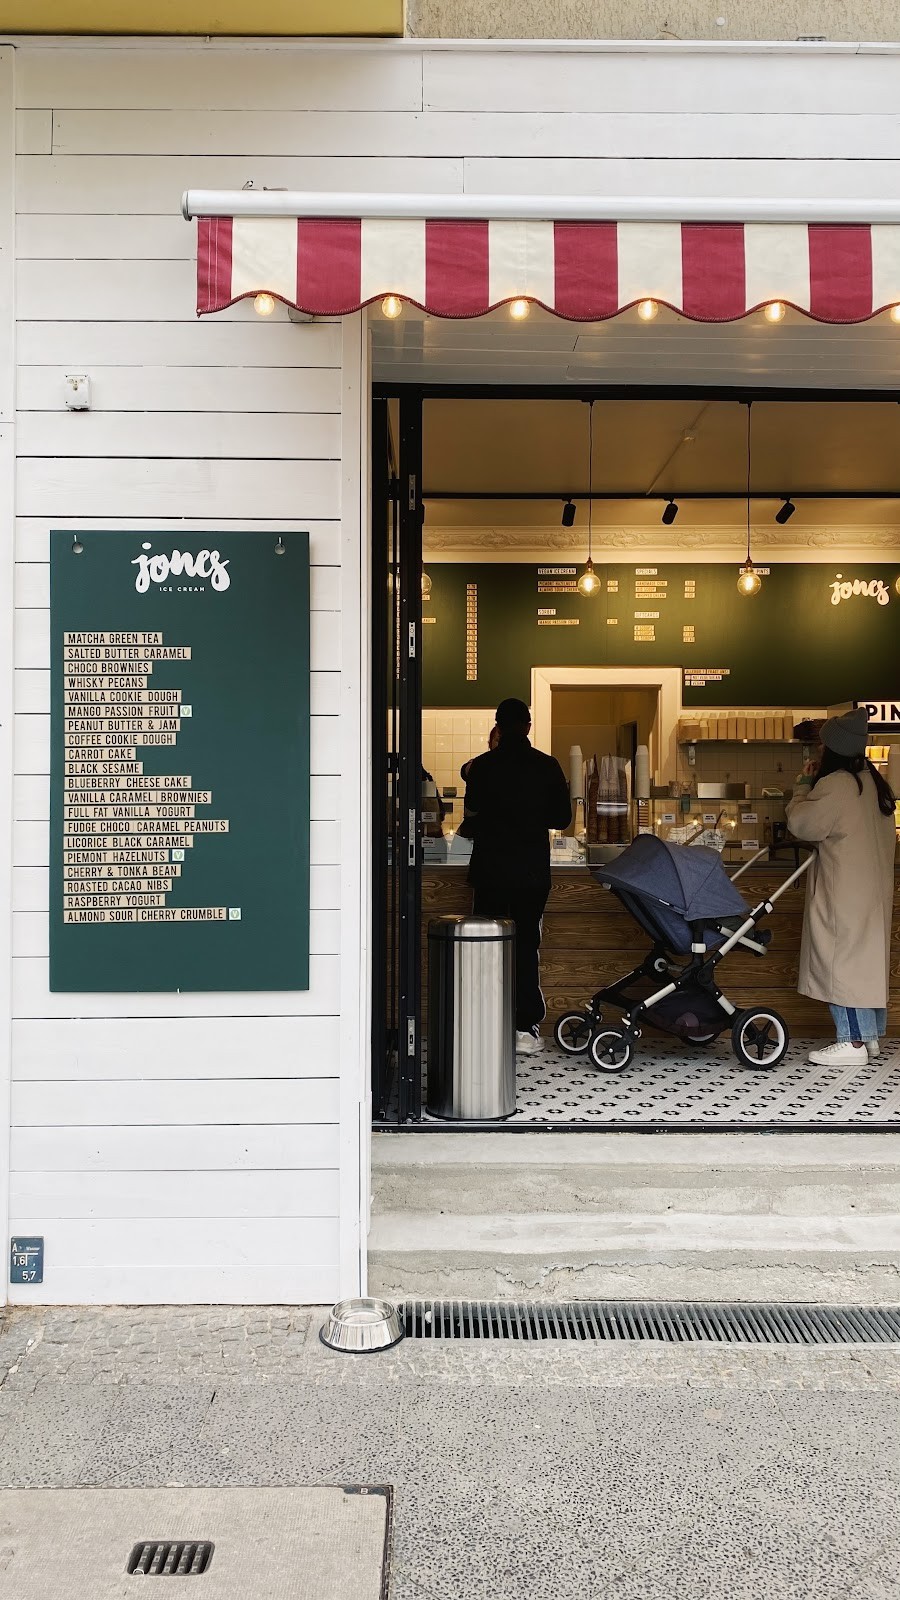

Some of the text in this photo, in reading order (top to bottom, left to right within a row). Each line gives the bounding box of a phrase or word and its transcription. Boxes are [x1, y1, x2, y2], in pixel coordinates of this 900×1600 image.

[131, 542, 230, 593] jones
[829, 573, 889, 606] jones
[69, 634, 159, 643] MATCHA GREEN TEA
[69, 649, 187, 658] SALTED BUTTER CARAMEL
[68, 663, 149, 673] CHOCO BROWNIES
[69, 678, 143, 687] WHISKY PECANS
[69, 692, 178, 703] VANILLA COOKIE DOUGH
[69, 707, 100, 716] MANGO
[105, 707, 143, 716] PASSION
[150, 706, 174, 715] FRUIT
[69, 720, 177, 730] PEANUT BUTTER & JAM
[69, 734, 172, 744] COFFEE COOKIE DOUGH
[69, 749, 132, 759] CARROT CAKE
[69, 764, 139, 775] BLACK SESAME
[69, 778, 188, 789] BLUEBERRY CHEESE CAKE
[69, 793, 208, 804] VANILLA CARAMEL BROWNIES
[69, 807, 191, 818] FULL FAT VANILLA YOGURT
[69, 820, 226, 833] FUDGE CHOCO CARAMEL PEANUTS
[68, 837, 189, 847] LICORICE BLACK CARAMEL
[68, 853, 107, 862] PIEMONT
[113, 852, 165, 863] HAZELNUTS
[68, 866, 177, 877] CHERRY & TONKA BEAN
[68, 880, 168, 892] ROASTED CACAO NIBS
[68, 894, 161, 907] RASPBERRY YOGURT
[68, 911, 105, 921] ALMOND
[110, 911, 133, 920] SOUR
[142, 908, 176, 920] CHERRY
[181, 910, 223, 921] CRUMBLE
[22, 1271, 36, 1281] 5,7
